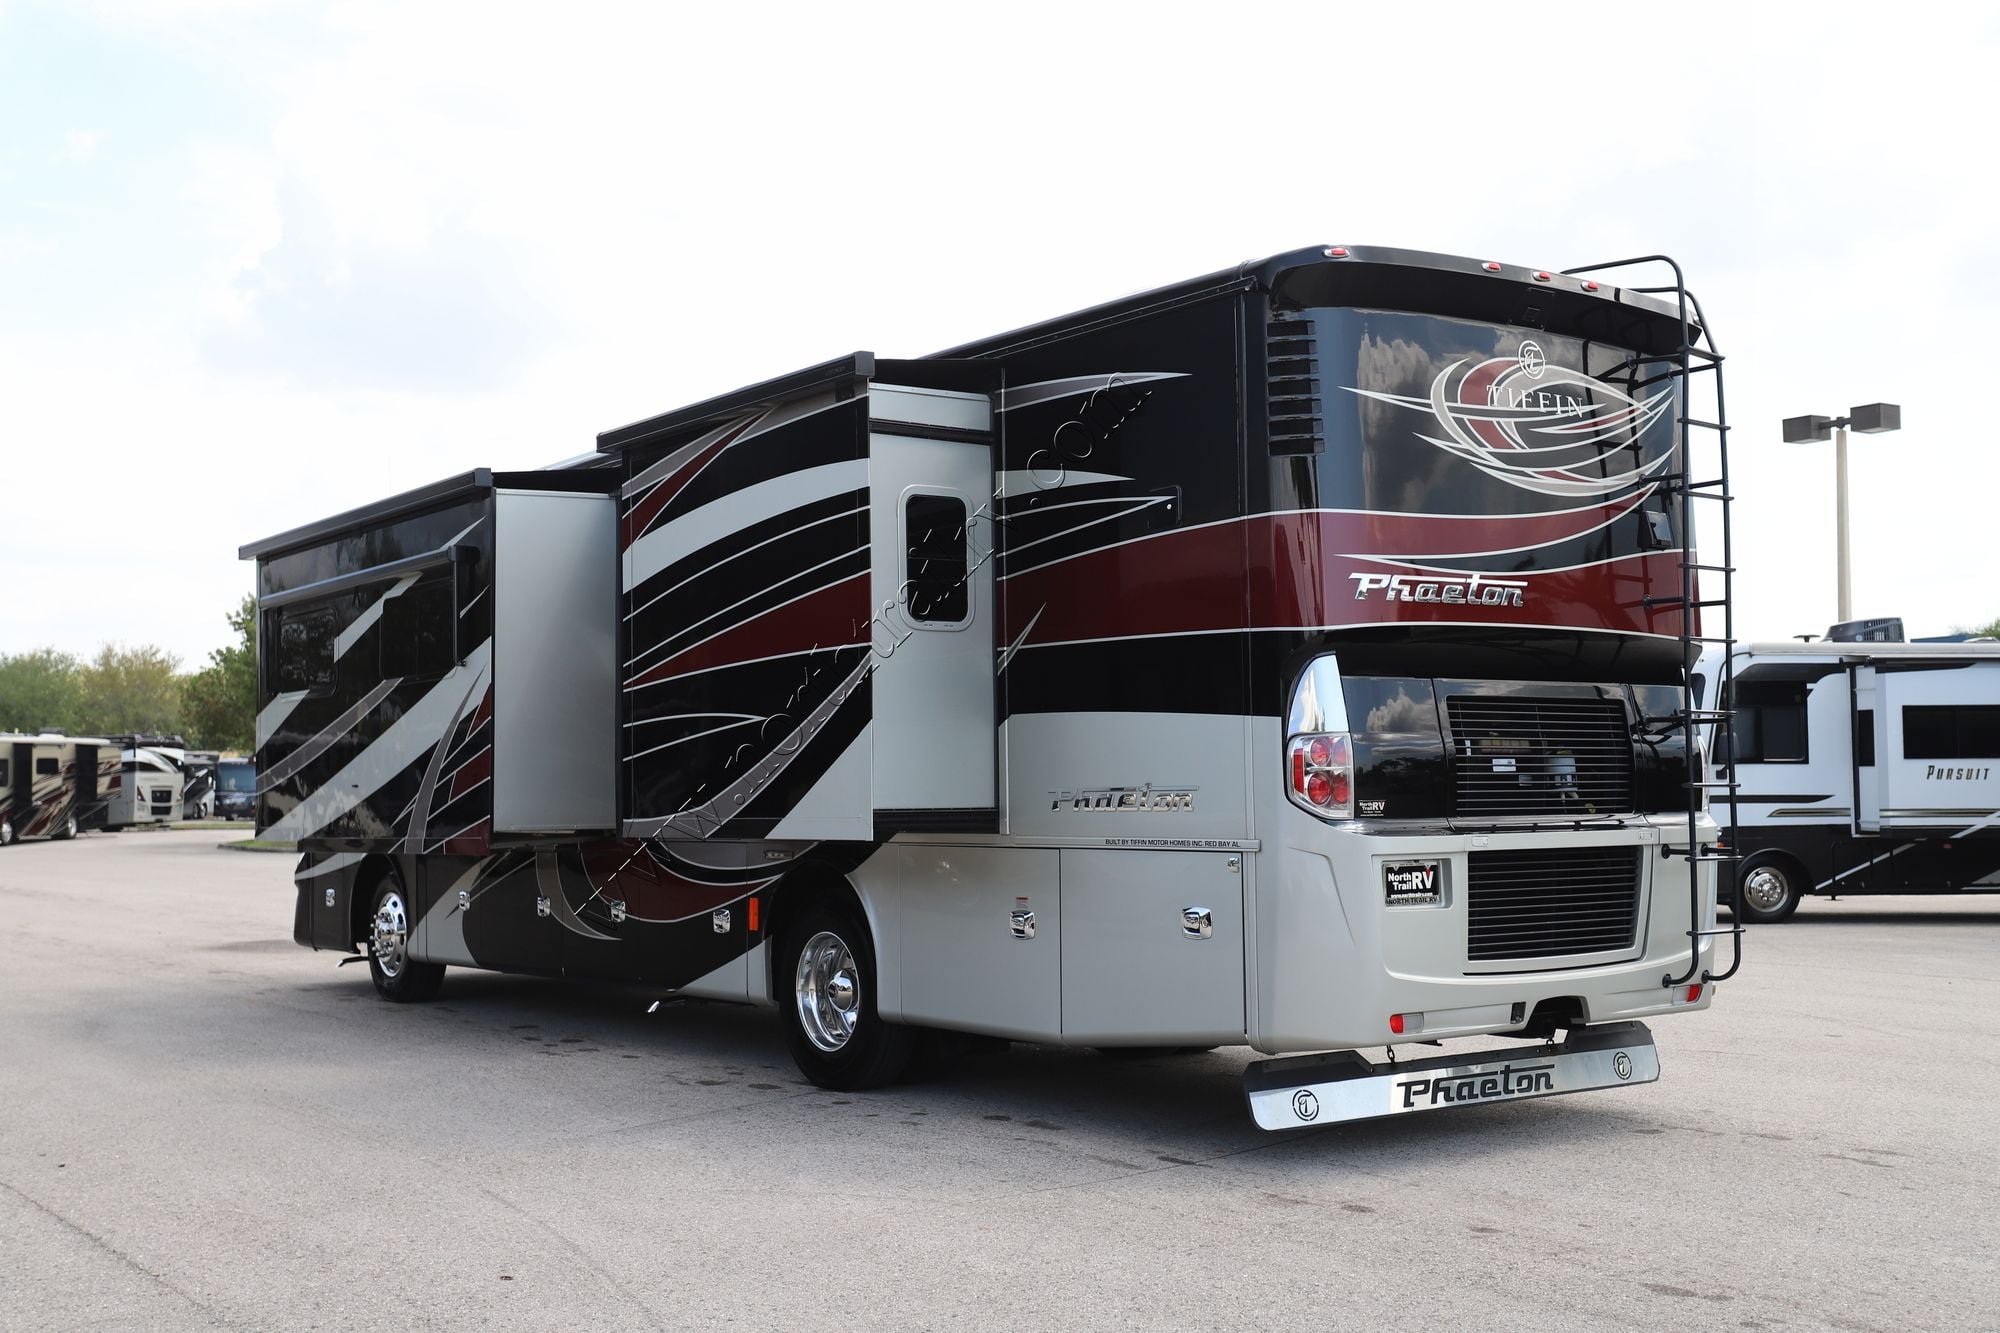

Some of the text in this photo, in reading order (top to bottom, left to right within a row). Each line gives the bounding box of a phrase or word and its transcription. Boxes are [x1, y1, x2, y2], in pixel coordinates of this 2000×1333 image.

[1486, 384, 1583, 418] TIFFIN
[1348, 572, 1529, 607] Phaeton
[1926, 765, 1990, 780] PURSUIT
[1372, 801, 1385, 811] RV
[1148, 839, 1169, 847] MOTOR
[1388, 871, 1434, 890] North RV
[1392, 882, 1412, 890] Trail
[1396, 1064, 1555, 1108] Phaeton
